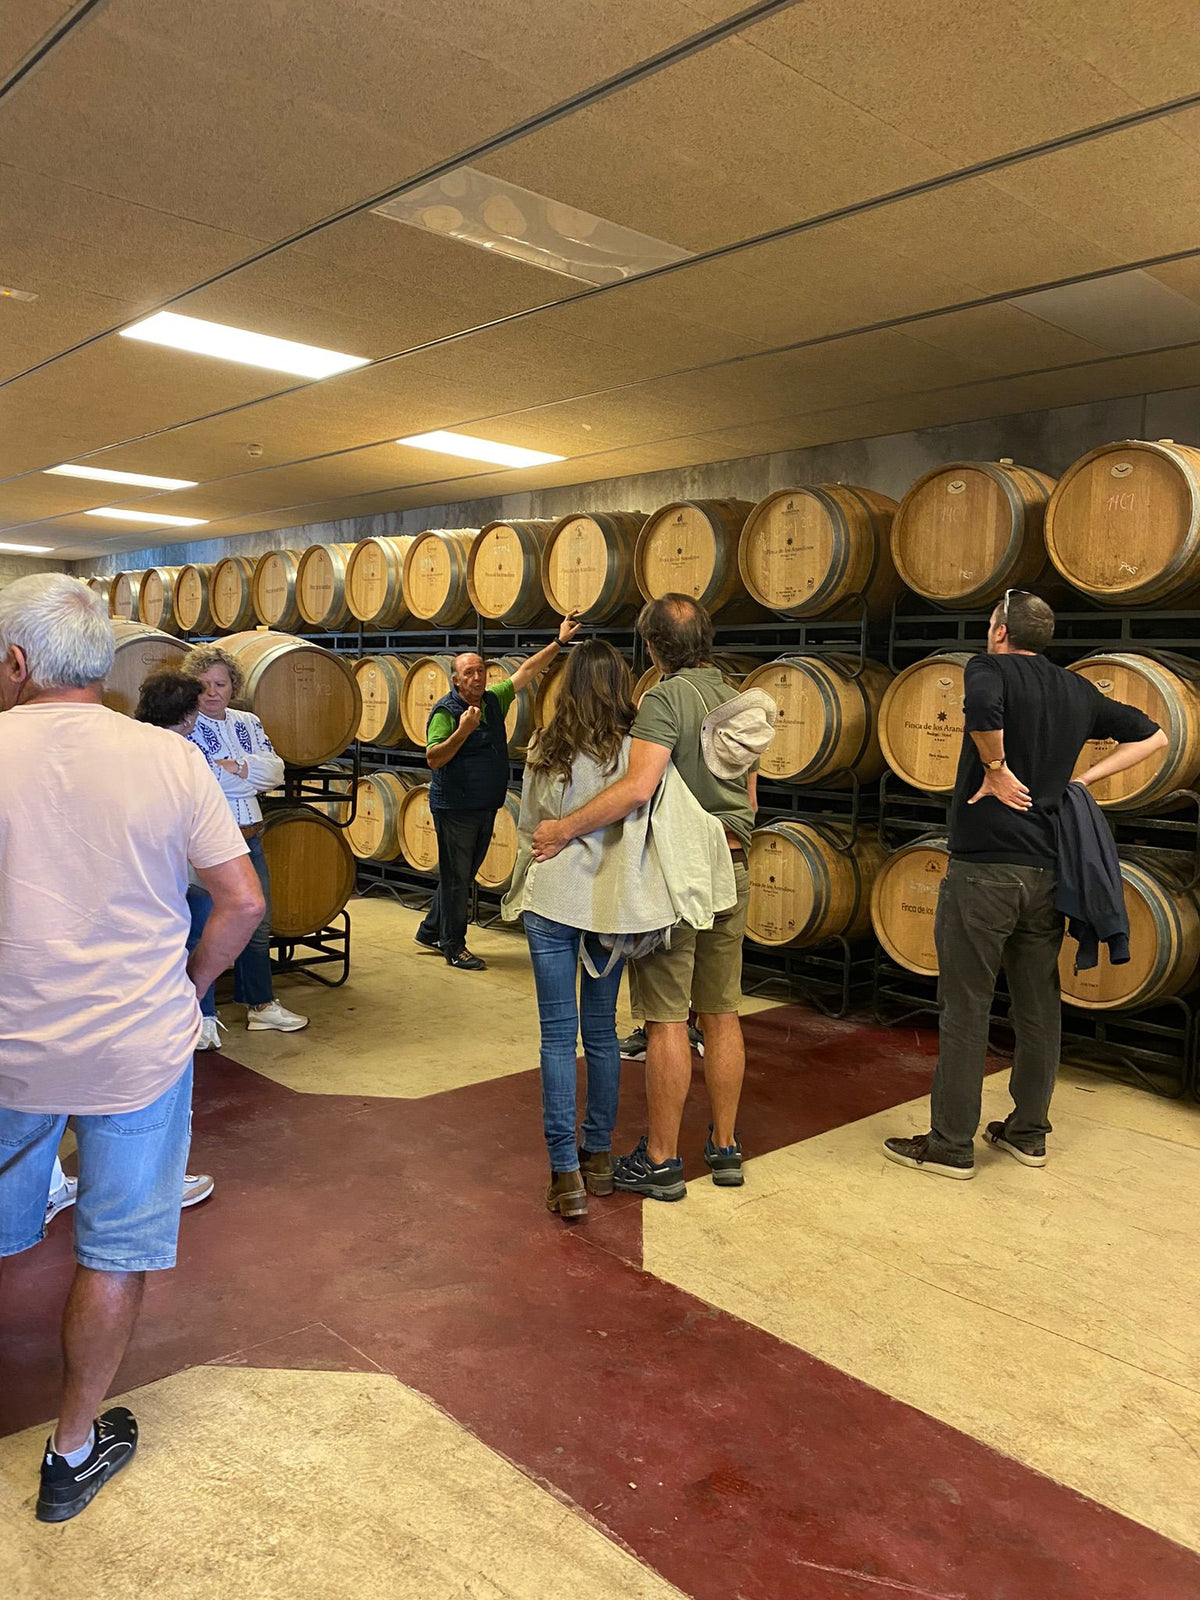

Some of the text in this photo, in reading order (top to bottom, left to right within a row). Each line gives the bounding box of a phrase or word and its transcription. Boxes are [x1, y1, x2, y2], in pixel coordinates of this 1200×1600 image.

[904, 721, 923, 730] Finca
[923, 722, 933, 731] de
[933, 723, 943, 731] los
[901, 902, 917, 913] Finca
[917, 904, 926, 915] de
